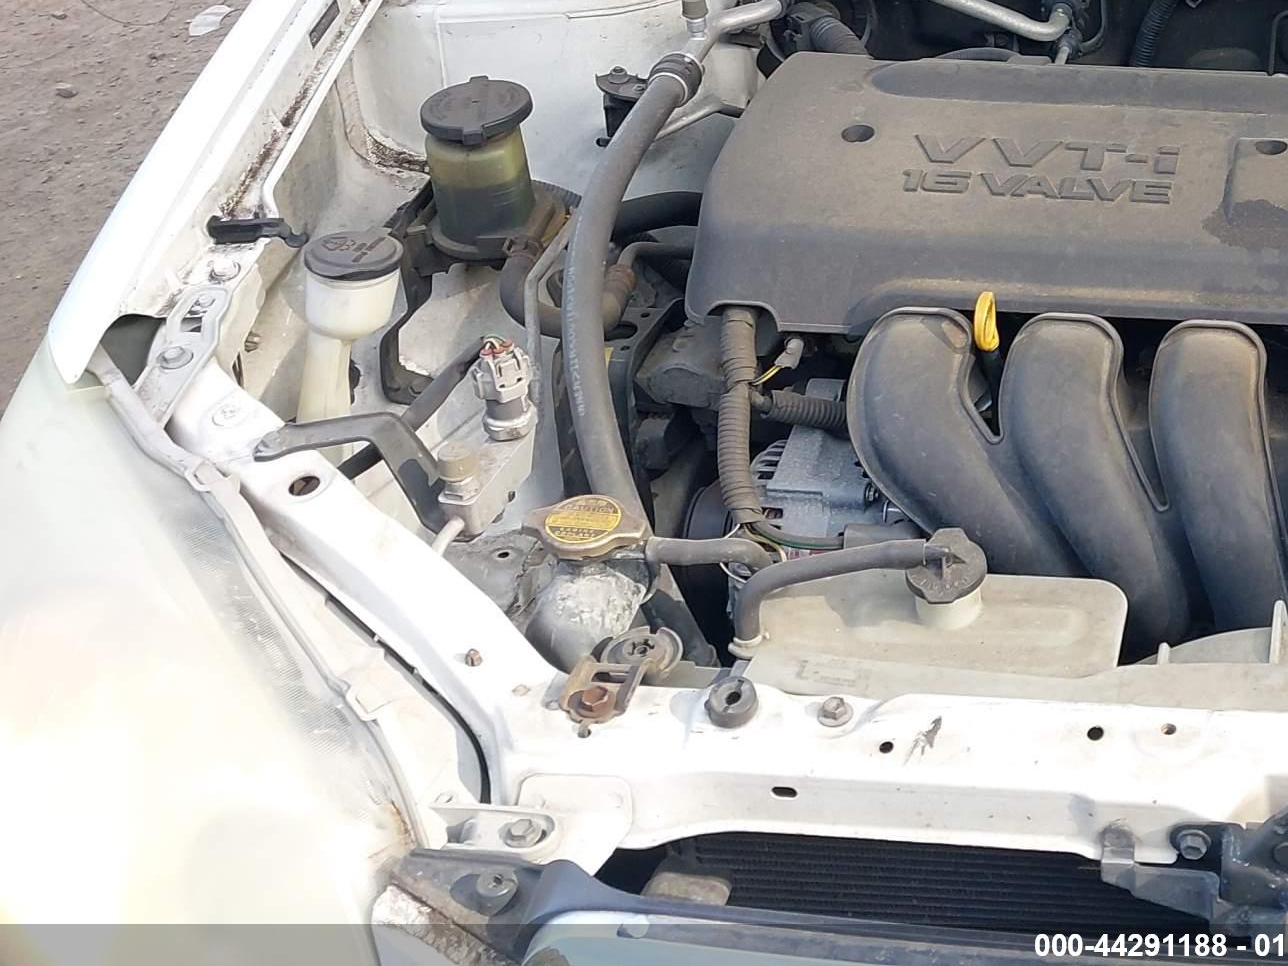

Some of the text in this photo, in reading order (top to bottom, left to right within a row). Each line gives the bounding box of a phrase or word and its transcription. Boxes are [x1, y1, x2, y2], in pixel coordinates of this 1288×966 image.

[914, 133, 1180, 175] VVT-i
[902, 169, 1172, 205] 16 VALVE
